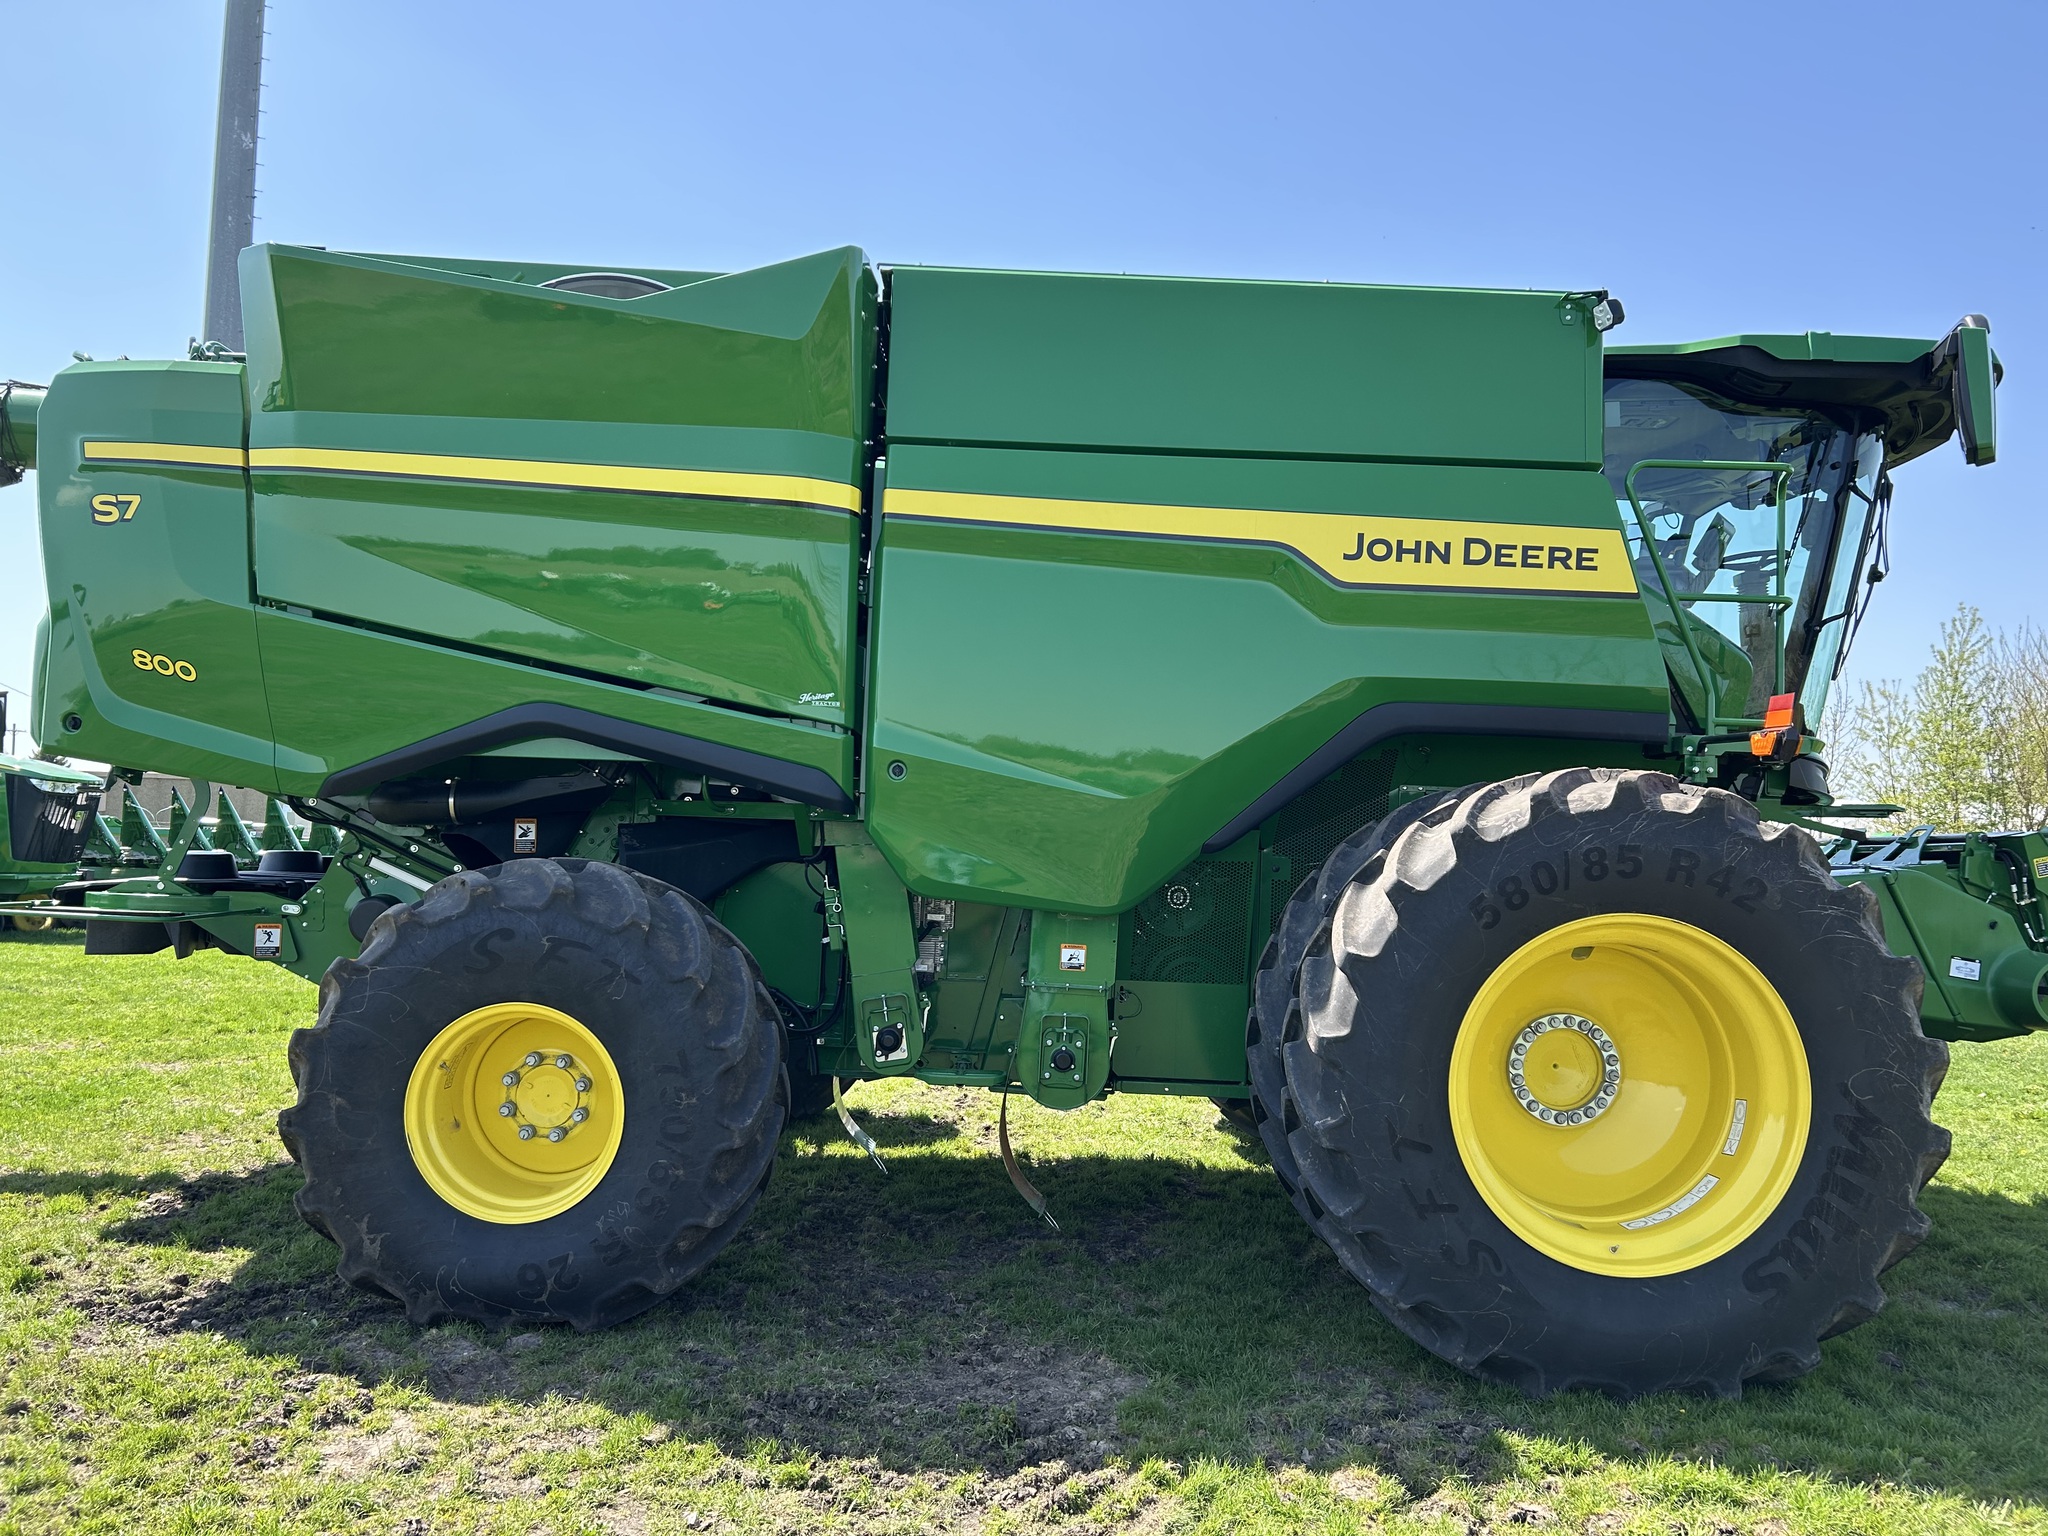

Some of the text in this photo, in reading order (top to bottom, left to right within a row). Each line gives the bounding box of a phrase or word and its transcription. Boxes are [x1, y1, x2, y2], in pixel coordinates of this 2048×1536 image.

[90, 493, 142, 526] S7
[1343, 533, 1600, 572] JOHN DEERE
[131, 648, 198, 683] 800
[798, 692, 835, 704] Heritage
[1468, 844, 1769, 931] 580/85 R42
